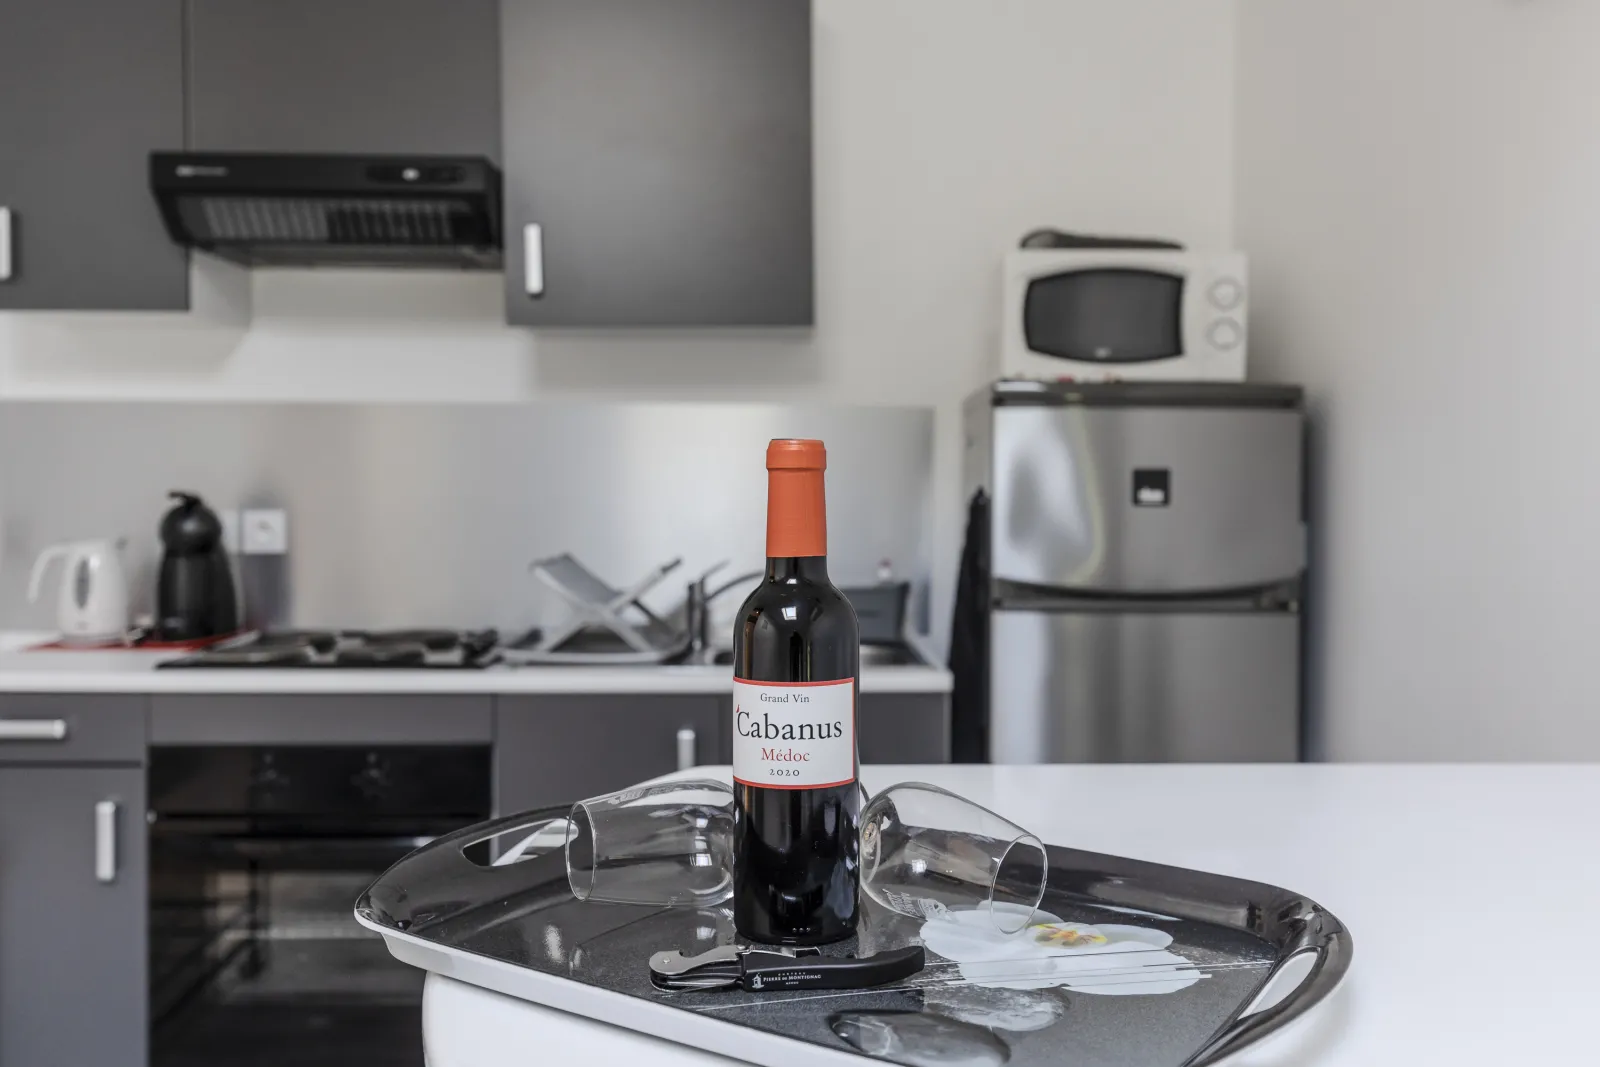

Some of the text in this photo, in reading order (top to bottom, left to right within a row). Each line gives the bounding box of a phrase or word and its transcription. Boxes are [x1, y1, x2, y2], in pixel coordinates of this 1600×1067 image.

[760, 693, 810, 703] Grand Vin
[737, 711, 842, 740] Cabanus
[761, 747, 810, 762] Médoc
[769, 768, 800, 777] 2020
